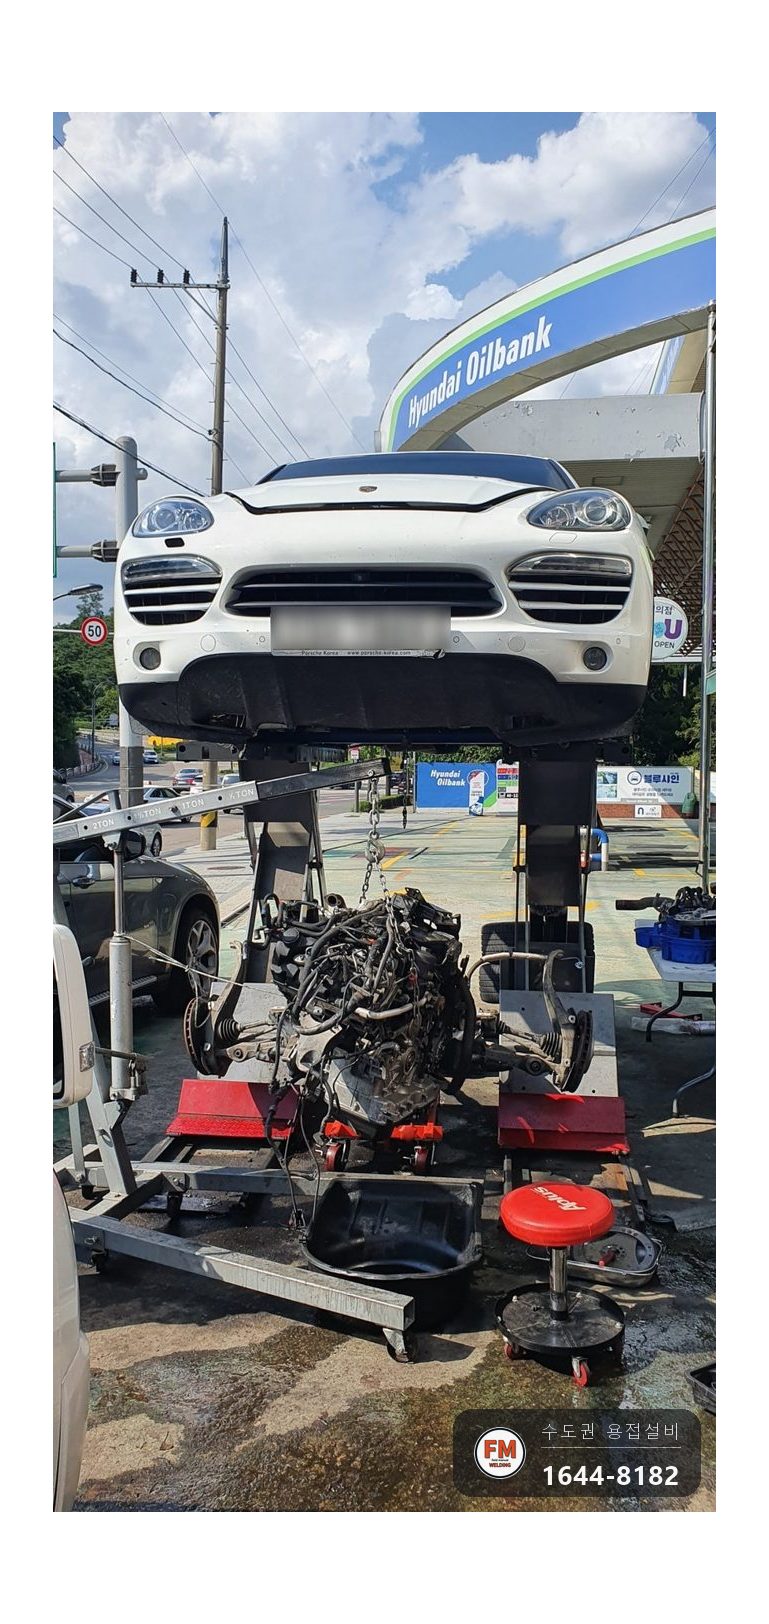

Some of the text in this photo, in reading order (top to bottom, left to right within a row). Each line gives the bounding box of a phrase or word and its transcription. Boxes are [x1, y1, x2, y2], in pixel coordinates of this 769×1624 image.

[408, 316, 552, 428] Hyundai Oilbank
[87, 625, 102, 637] 50
[654, 640, 675, 649] OPEN
[430, 769, 461, 779] Hyundai
[437, 778, 465, 787] Oilbank
[92, 818, 115, 829] 2TON
